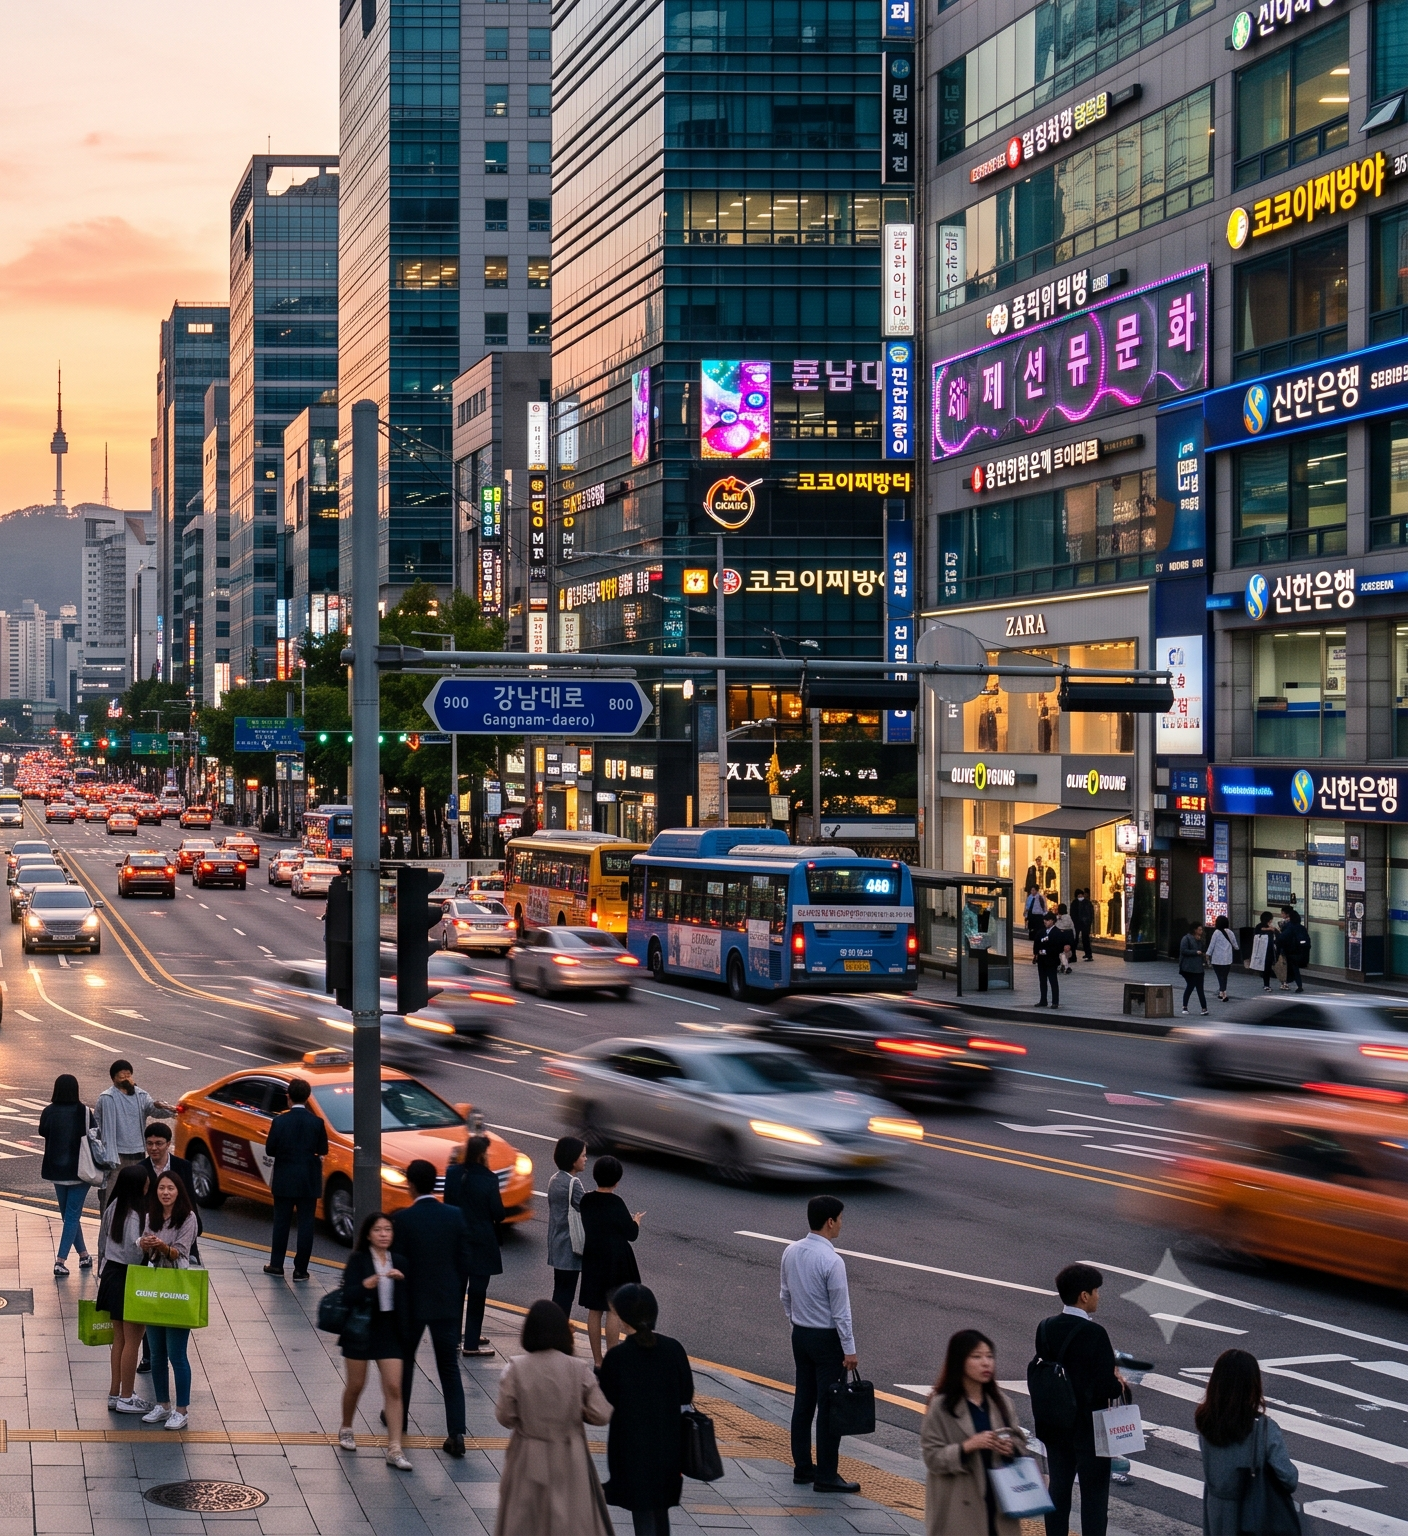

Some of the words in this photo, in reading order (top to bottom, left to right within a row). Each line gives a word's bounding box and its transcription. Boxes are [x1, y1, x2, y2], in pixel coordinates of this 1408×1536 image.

[1253, 151, 1386, 237] 코코이찌방야
[1273, 365, 1360, 424] 신한은행
[1273, 568, 1355, 614] 신한은행
[1006, 613, 1047, 637] ZARA
[443, 696, 469, 709] 900
[494, 686, 585, 711] 강남대로
[609, 698, 634, 711] 800
[483, 713, 595, 729] Gangnam-daero)
[1318, 776, 1398, 814] 신한은행
